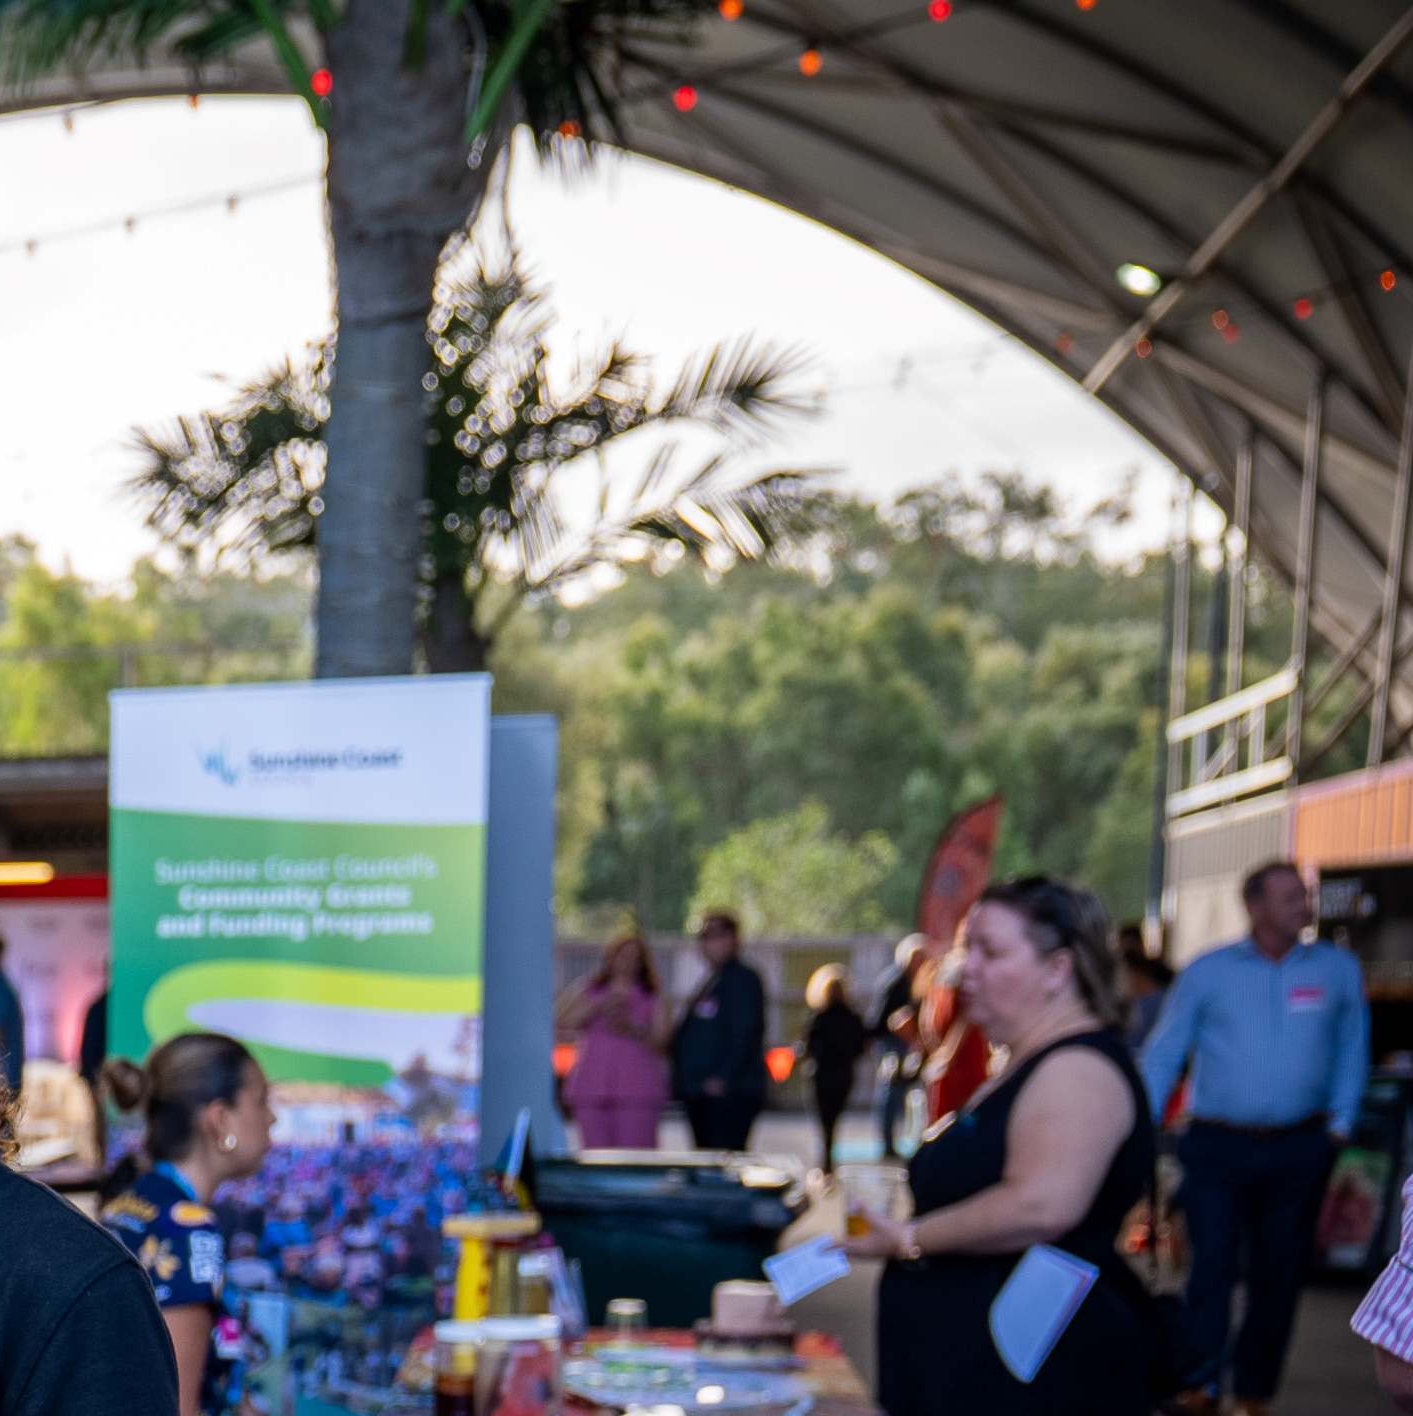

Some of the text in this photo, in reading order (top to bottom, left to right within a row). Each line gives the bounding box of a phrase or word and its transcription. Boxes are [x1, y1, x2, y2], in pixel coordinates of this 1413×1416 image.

[155, 856, 256, 884] Sunshine
[265, 856, 329, 882] Coast
[156, 913, 203, 938] and
[209, 912, 309, 942] Funding
